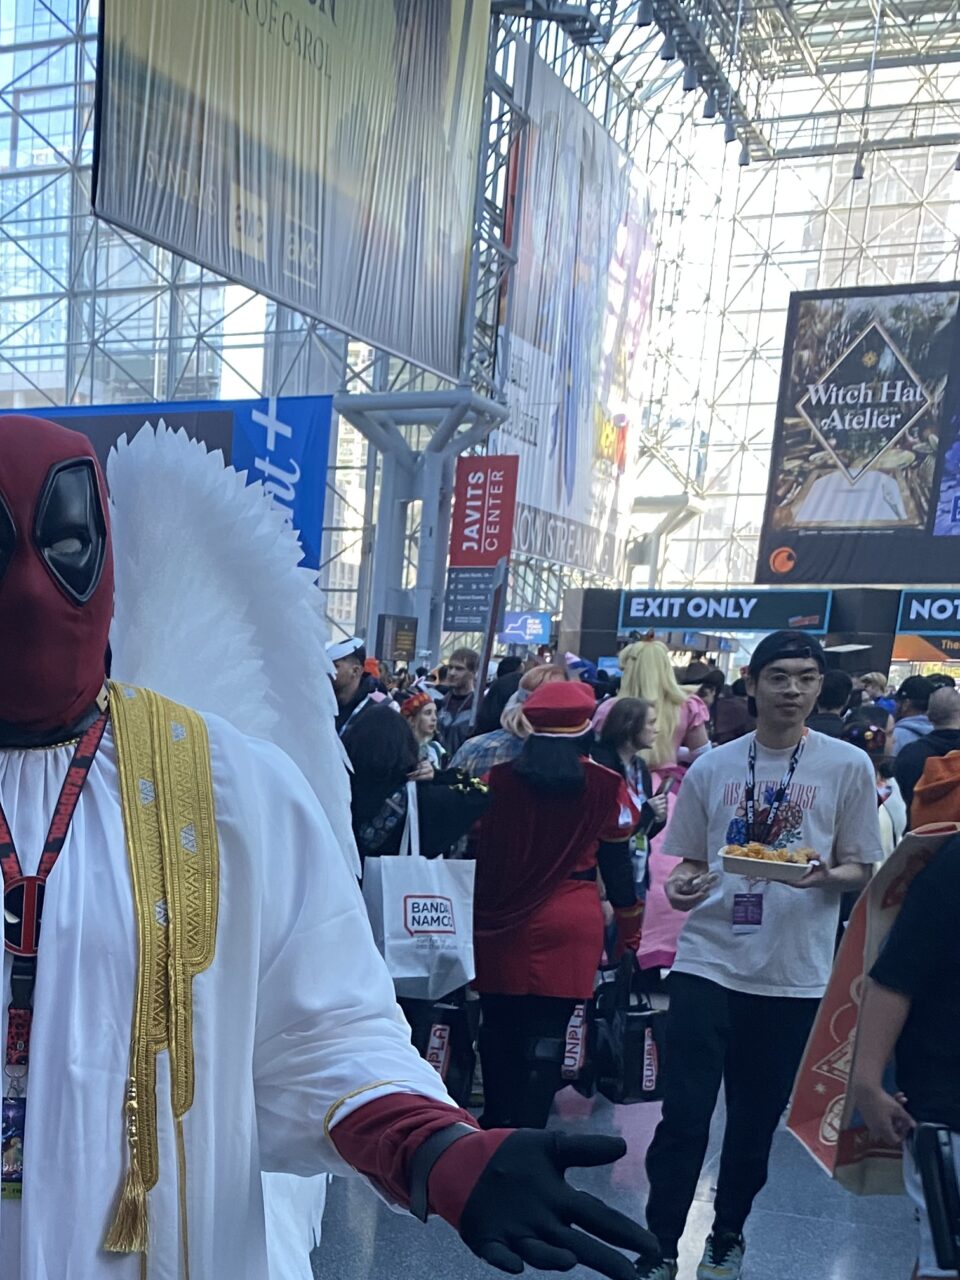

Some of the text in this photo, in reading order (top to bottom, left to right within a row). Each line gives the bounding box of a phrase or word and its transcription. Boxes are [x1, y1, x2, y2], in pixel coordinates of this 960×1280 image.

[281, 11, 332, 79] CAROL
[807, 380, 924, 406] Witch Hat
[821, 410, 903, 431] Atelier
[251, 396, 301, 520] nt+
[462, 471, 485, 551] JAVITS
[485, 470, 504, 551] CENTER
[512, 504, 609, 572] NOW STREAMG
[630, 597, 758, 619] EXIT ONLY
[412, 902, 450, 914] BANDA
[428, 1027, 447, 1071] PLA
